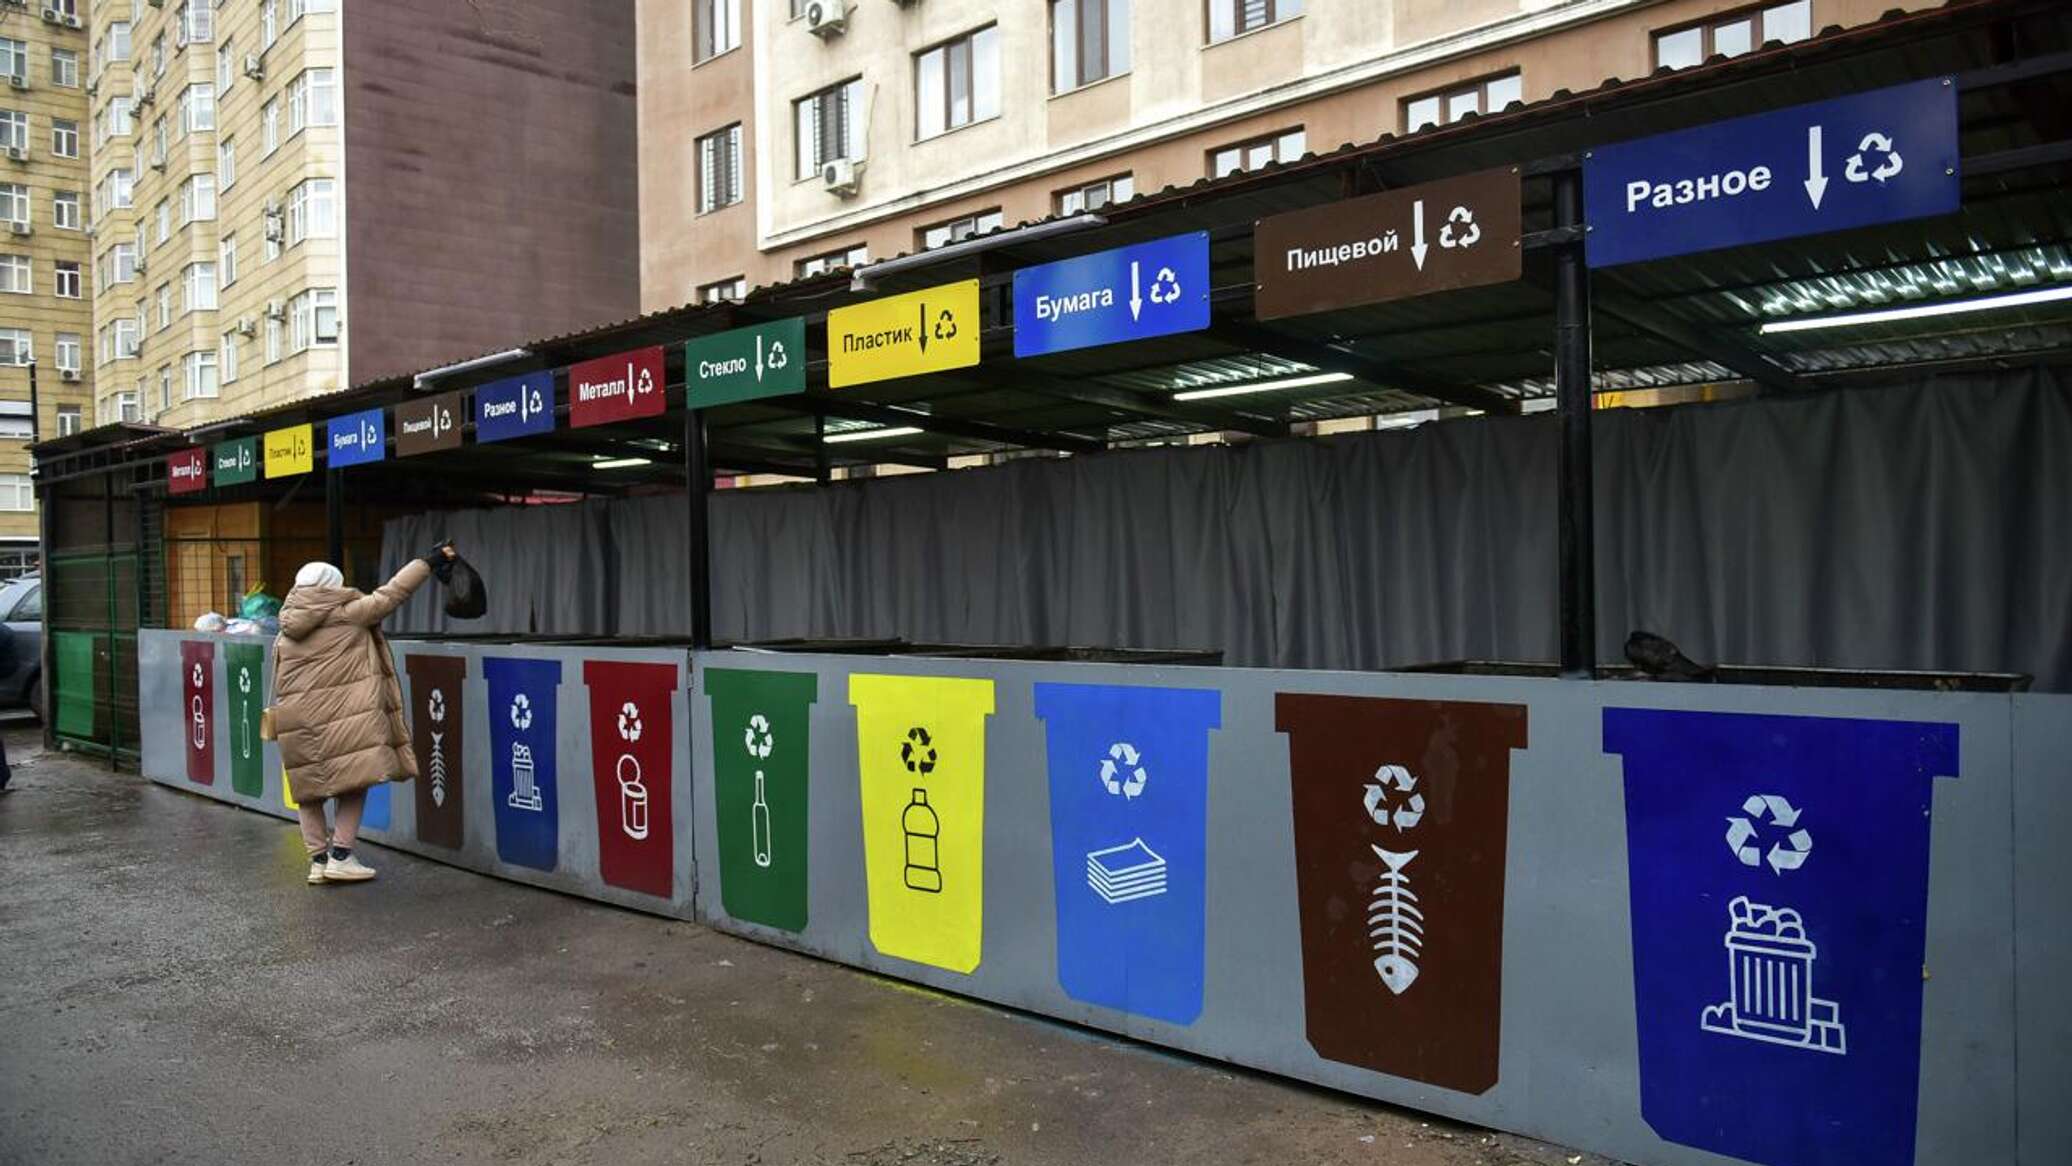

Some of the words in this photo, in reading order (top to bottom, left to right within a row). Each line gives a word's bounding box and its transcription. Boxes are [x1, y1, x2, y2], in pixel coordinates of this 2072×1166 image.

[1627, 163, 1772, 212] Разное
[1287, 229, 1398, 271] Пищевой
[1036, 288, 1113, 322] Бумага
[843, 327, 913, 353] Пластик
[699, 357, 747, 379] Стекло
[579, 379, 625, 401] Металл
[484, 400, 517, 418] Разное
[334, 433, 358, 449] Бумага
